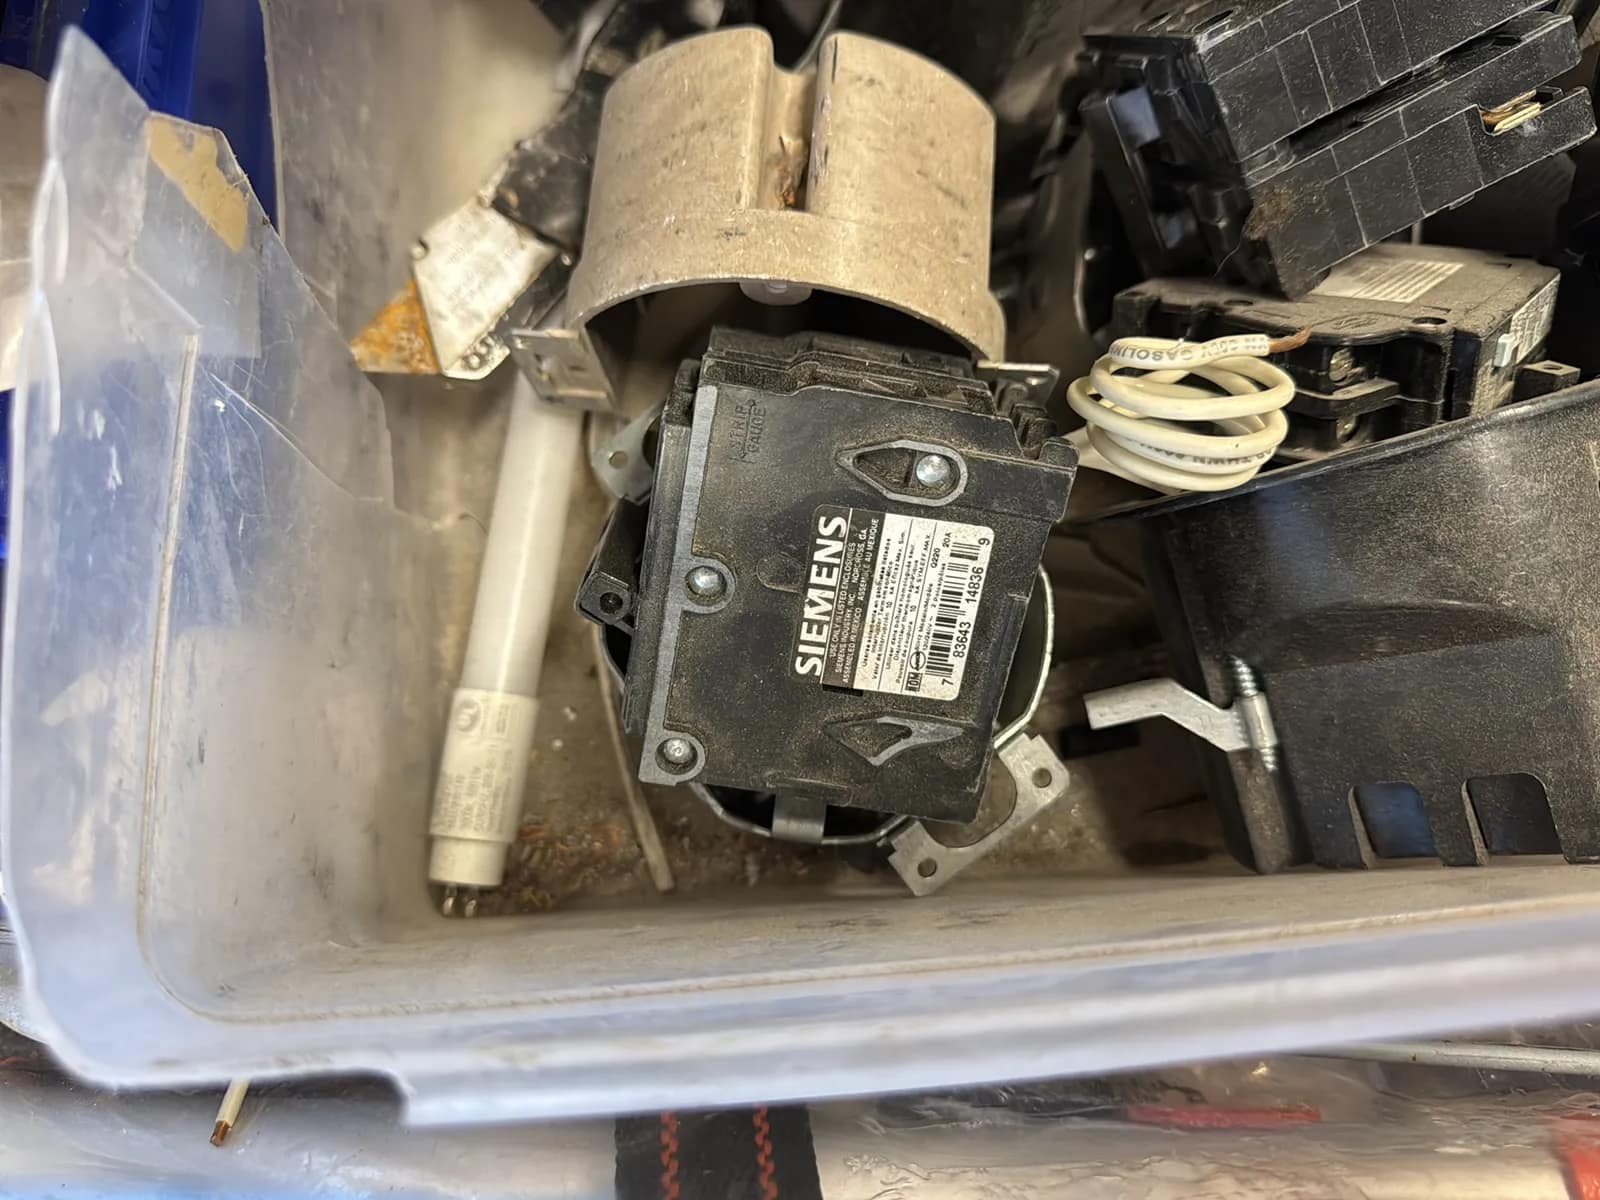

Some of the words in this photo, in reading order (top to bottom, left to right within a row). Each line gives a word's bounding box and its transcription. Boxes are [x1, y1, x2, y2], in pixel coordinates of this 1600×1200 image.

[866, 518, 879, 550] MEXIQUE
[942, 532, 951, 547] 20A
[864, 551, 872, 562] AU
[930, 547, 940, 568] Q220
[794, 516, 846, 676] SIEMENS
[952, 621, 971, 658] 83643
[964, 566, 983, 603] 14836
[977, 537, 990, 545] 9
[831, 623, 840, 642] ONLY
[836, 590, 847, 614] LISTED
